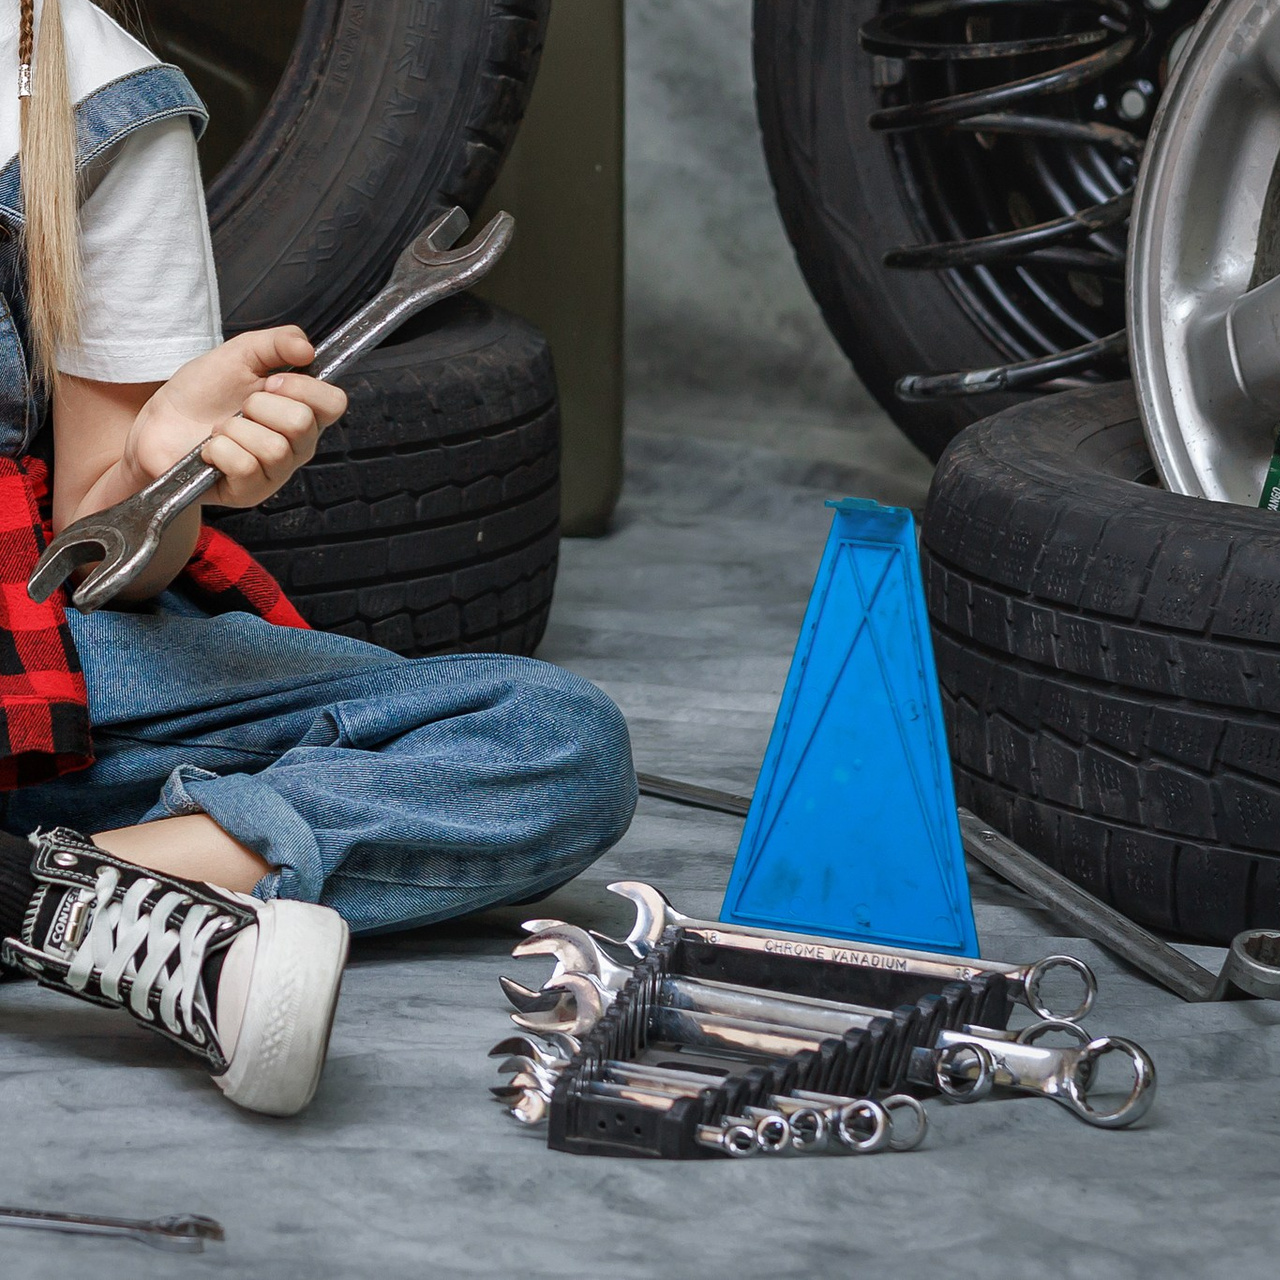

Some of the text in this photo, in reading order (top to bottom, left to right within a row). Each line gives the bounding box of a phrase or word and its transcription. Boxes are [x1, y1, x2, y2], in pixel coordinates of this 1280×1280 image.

[703, 930, 718, 944] 18
[764, 938, 825, 960] CHROME
[831, 948, 908, 972] VANADIUM
